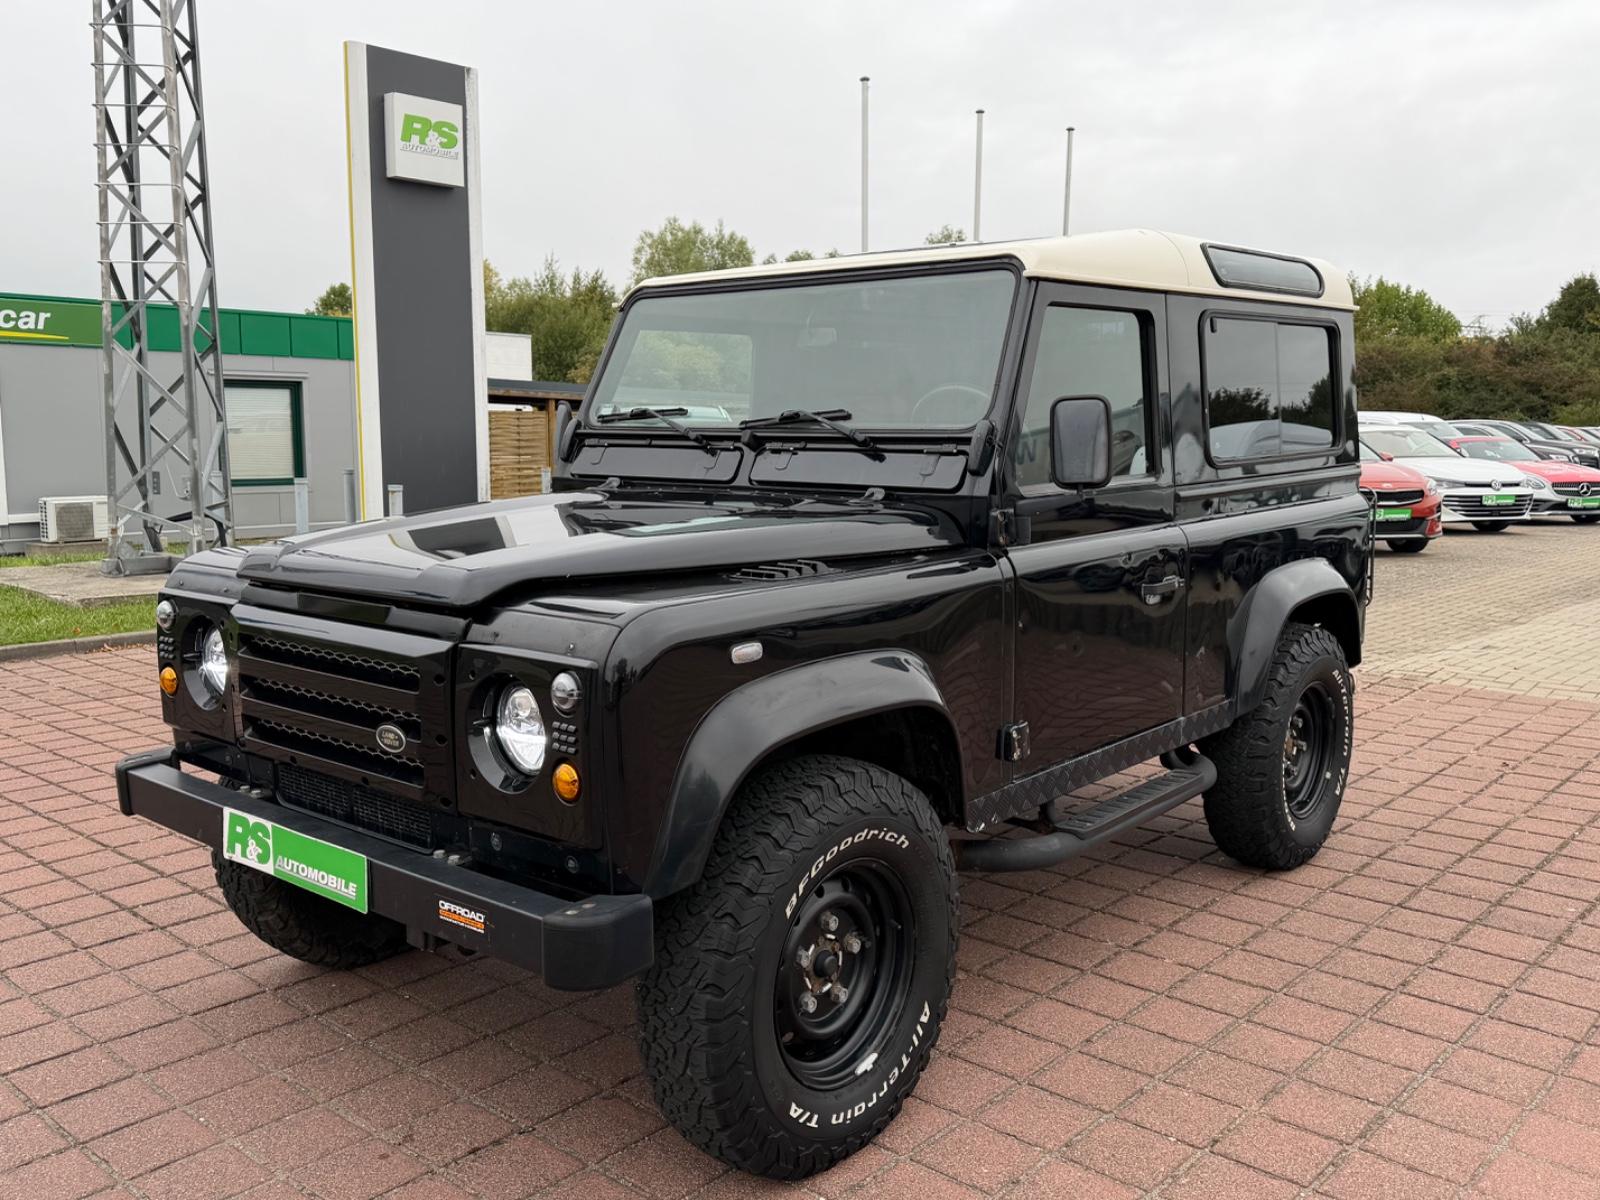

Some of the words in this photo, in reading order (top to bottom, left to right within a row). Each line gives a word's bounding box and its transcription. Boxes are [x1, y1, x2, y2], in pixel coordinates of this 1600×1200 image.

[226, 811, 271, 865] R&S
[275, 855, 357, 897] AUTOMOBILE
[785, 827, 910, 919] BFGoodrich
[439, 900, 484, 923] OFFROAD
[831, 1001, 931, 1126] All-Terrain
[789, 1102, 819, 1128] T/A
